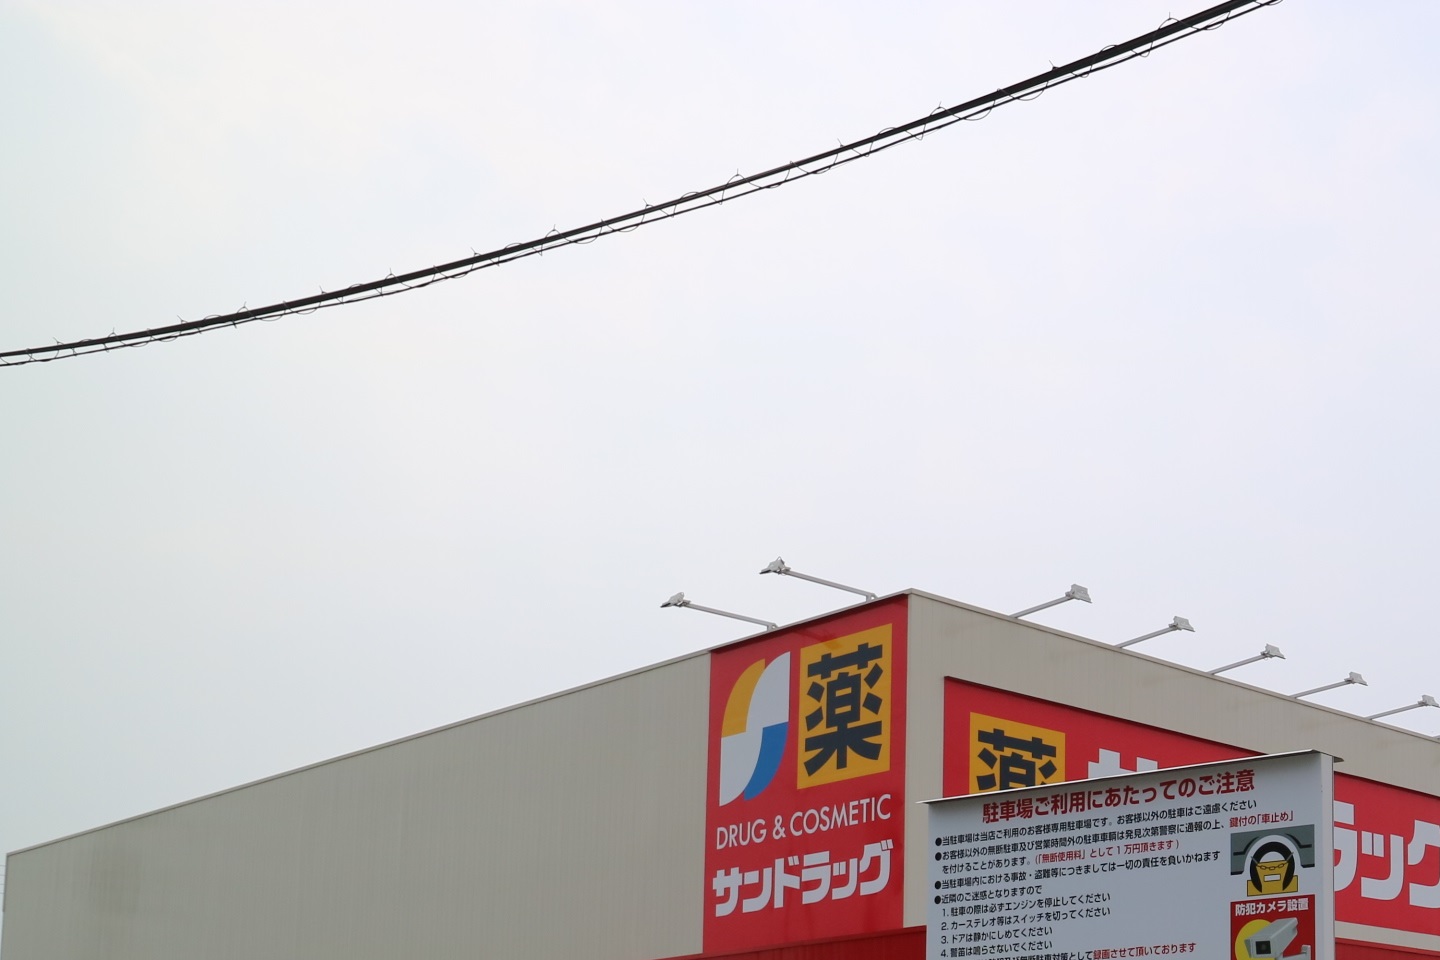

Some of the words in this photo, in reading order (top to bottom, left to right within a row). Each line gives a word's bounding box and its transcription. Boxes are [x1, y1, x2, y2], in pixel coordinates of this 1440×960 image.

[803, 642, 883, 776] 薬
[716, 818, 766, 850] DRUG
[772, 815, 786, 840] &
[790, 794, 891, 837] COSMETIC
[983, 769, 1255, 824] 駐車場ご利用にあたってのご注意
[712, 838, 893, 917] サンドラッグ
[1235, 897, 1309, 917] 防犯カメラ設置
